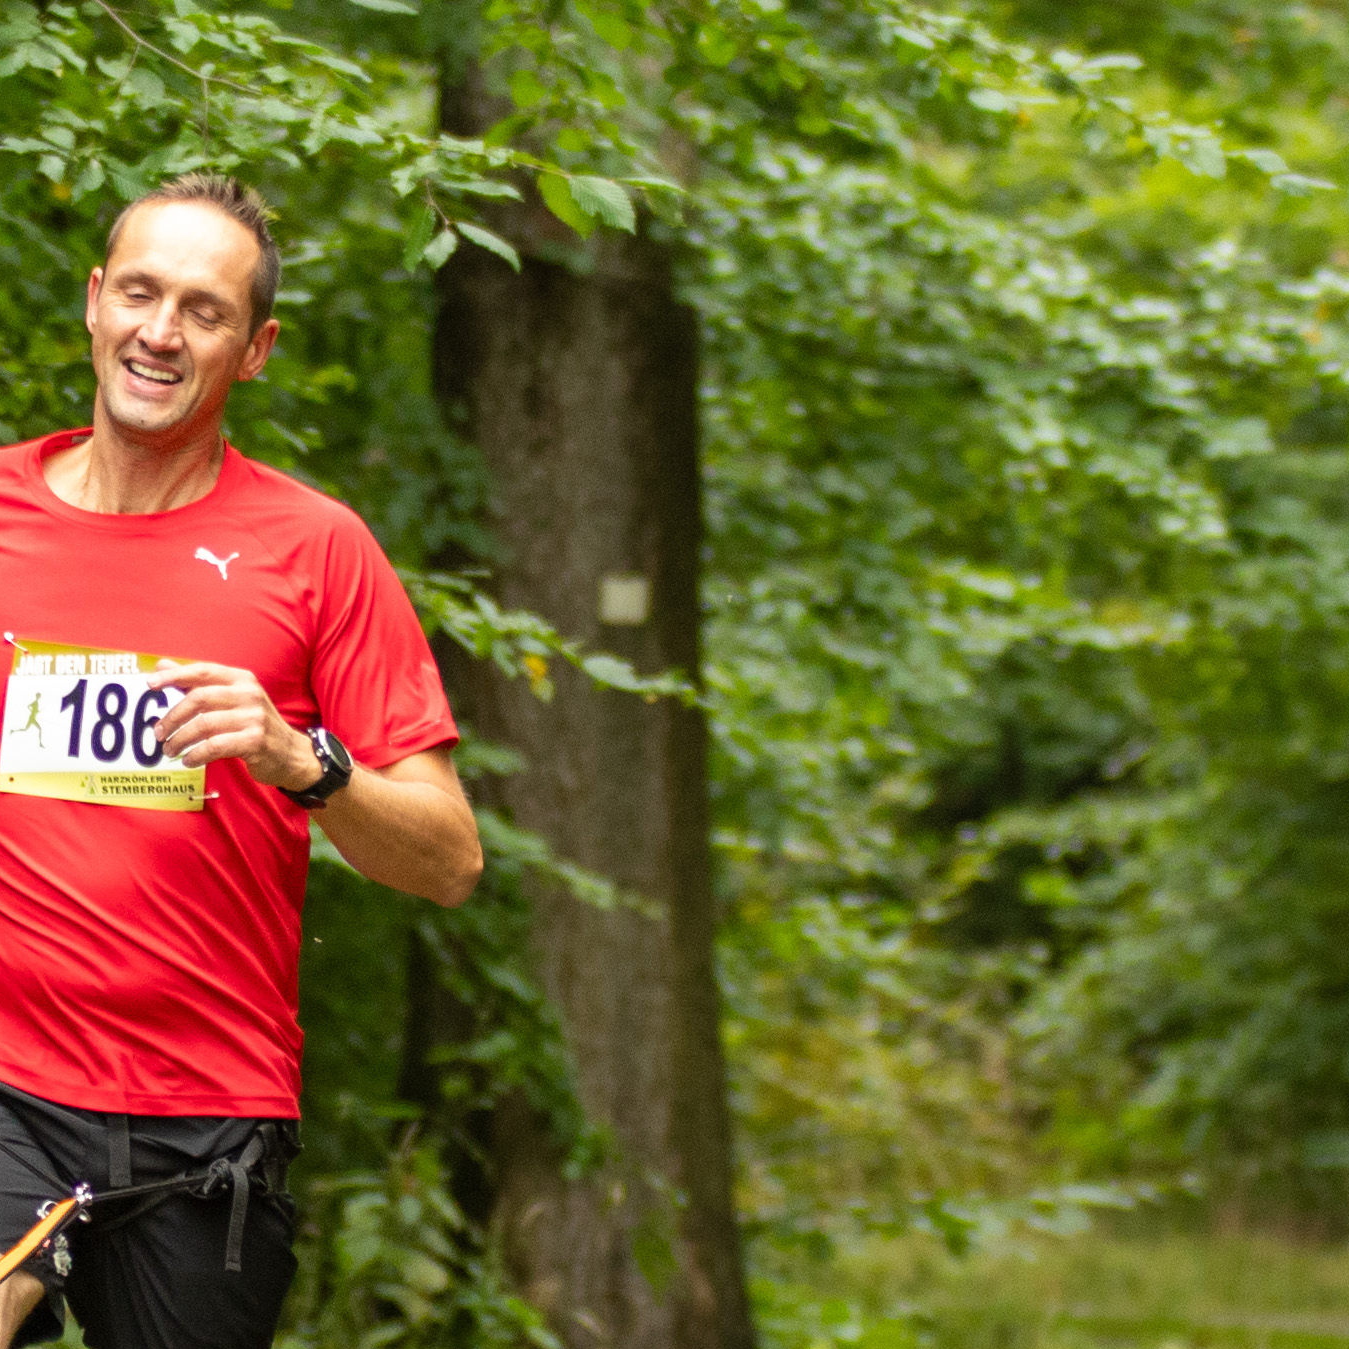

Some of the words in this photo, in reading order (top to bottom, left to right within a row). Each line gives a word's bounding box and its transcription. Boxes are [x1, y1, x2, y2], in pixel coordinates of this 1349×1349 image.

[55, 655, 86, 675] DEN
[89, 654, 140, 675] TEUFEL
[60, 678, 169, 768] 186
[101, 784, 195, 795] STEMBERGHAUS
